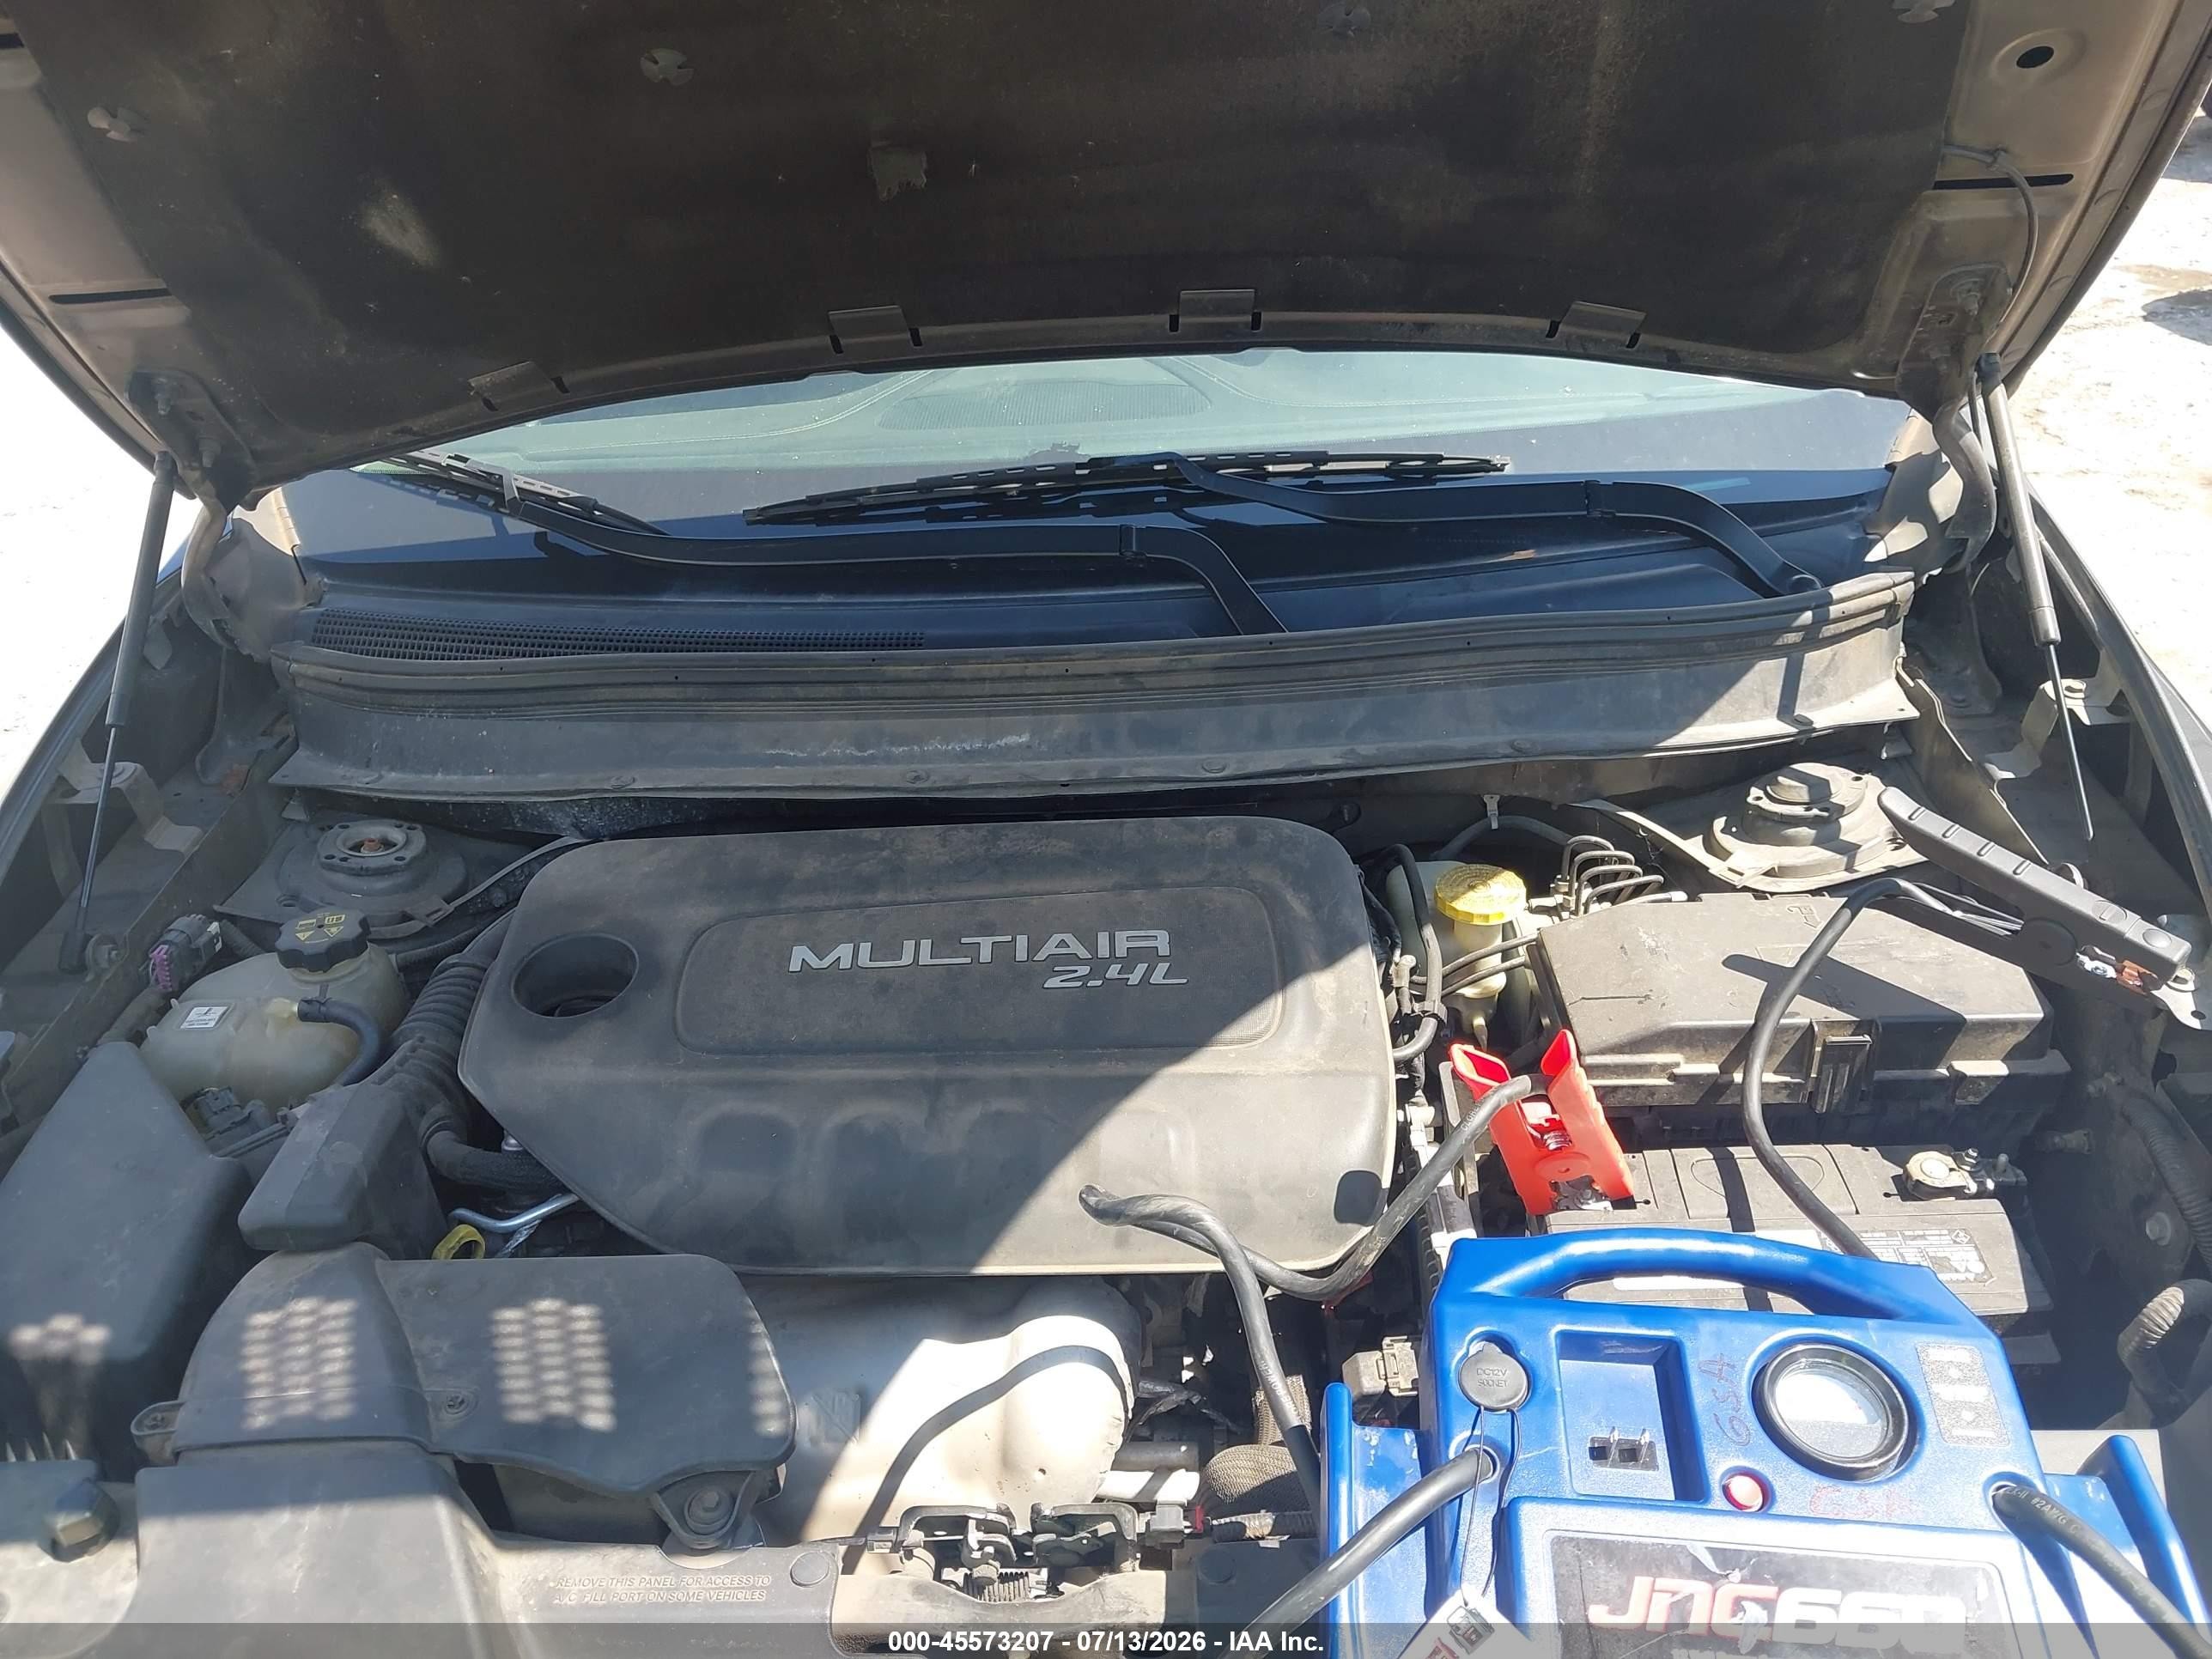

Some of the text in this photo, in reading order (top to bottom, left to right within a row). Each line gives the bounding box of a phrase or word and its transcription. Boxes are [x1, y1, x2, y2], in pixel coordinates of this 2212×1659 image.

[788, 929, 1171, 973] MULTIAIR
[1042, 963, 1188, 989] 2.4L
[556, 1575, 771, 1589] REMOVE THIS PANEL FOR ACCESS TO
[582, 1592, 607, 1603] FILL
[610, 1591, 644, 1603] PORT
[646, 1591, 666, 1602] ON
[667, 1591, 705, 1602] SOME
[707, 1590, 767, 1602] VEHICLES
